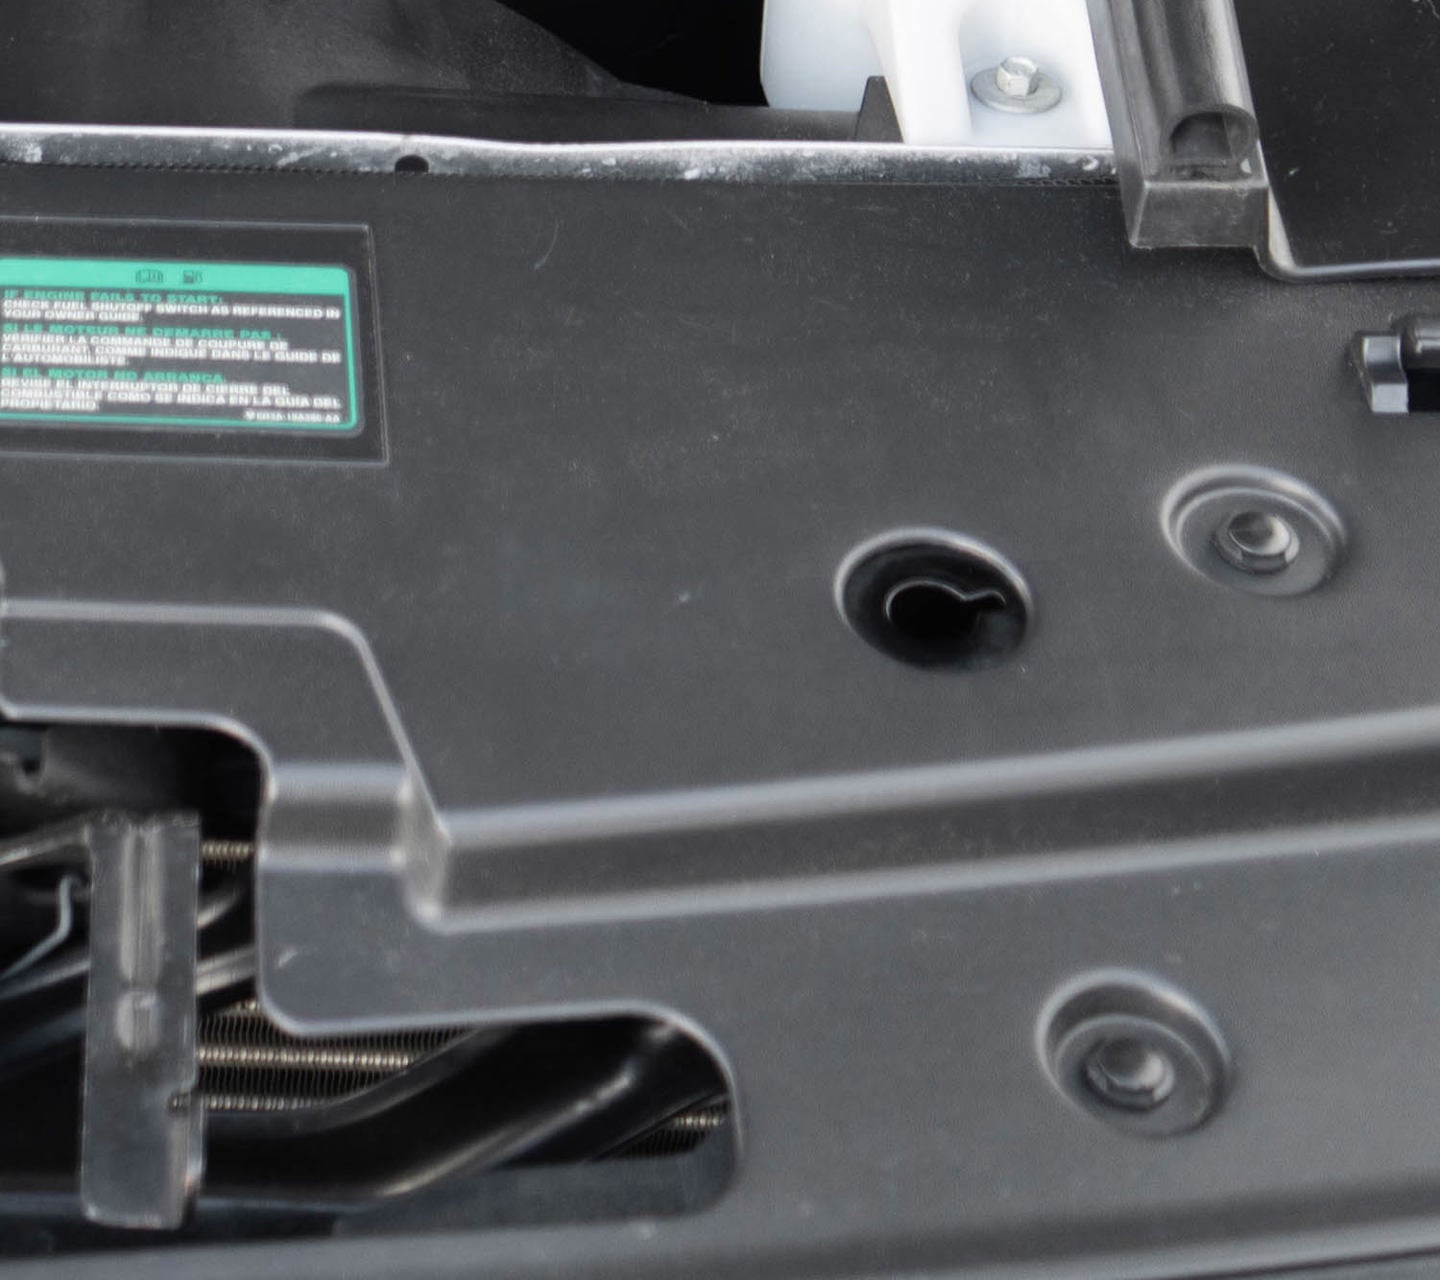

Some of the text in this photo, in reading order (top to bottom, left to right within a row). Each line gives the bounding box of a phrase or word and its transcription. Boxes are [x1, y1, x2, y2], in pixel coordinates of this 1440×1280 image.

[3, 289, 18, 298] IF
[22, 289, 85, 300] ENGINE
[90, 291, 134, 301] FAILS
[140, 292, 161, 302] TO
[2, 299, 341, 318] CHECK FUEL SHUTOFF SWITCH AS REFERENCED IN
[3, 308, 42, 319] YOUR
[43, 309, 95, 320] OWNER
[2, 322, 18, 333] SI
[24, 323, 42, 333] LE
[48, 323, 120, 335] MOTEUR
[124, 325, 146, 336] NE
[238, 328, 271, 339] PAS
[68, 334, 87, 344] LA
[89, 335, 170, 347] COMMANDE
[174, 337, 193, 347] DE
[196, 337, 266, 349] COUPURE
[268, 339, 288, 350] DE
[210, 348, 250, 359] DANS
[252, 349, 270, 360] LE
[273, 350, 318, 361] GUIDE
[320, 351, 341, 362] DE
[0, 367, 18, 378] SI
[22, 367, 40, 378] EL
[48, 368, 109, 380] MOTOR
[113, 369, 138, 381] NO
[55, 379, 72, 389] EL
[181, 382, 202, 392] DE
[204, 383, 258, 394] CIERRE
[261, 384, 290, 395] DEL
[106, 391, 151, 402] COMO
[154, 392, 172, 403] SE
[176, 393, 226, 404] INDICA
[228, 394, 249, 405] EN
[252, 395, 272, 406] LA
